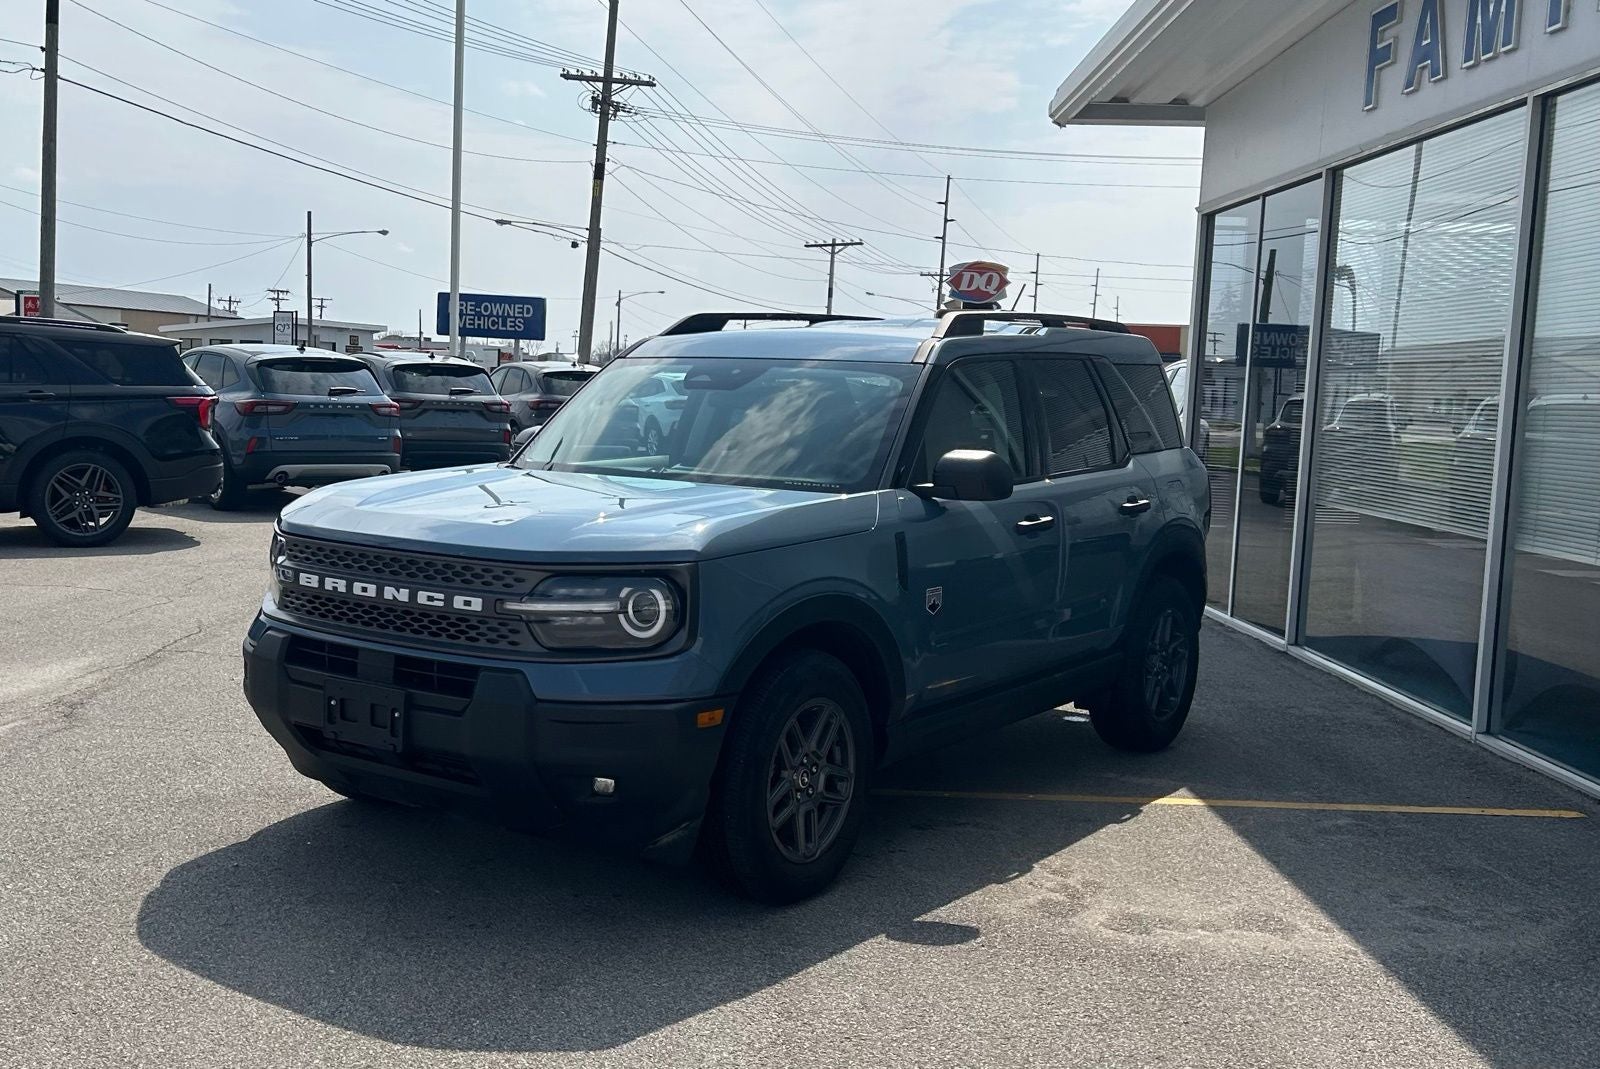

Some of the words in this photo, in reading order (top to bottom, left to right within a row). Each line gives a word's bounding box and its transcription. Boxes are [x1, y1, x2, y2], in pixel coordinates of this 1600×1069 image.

[958, 271, 1001, 295] DQ
[448, 301, 534, 318] RE-OWNED
[458, 315, 525, 331] VEHICLES
[299, 572, 483, 612] BRONCO
